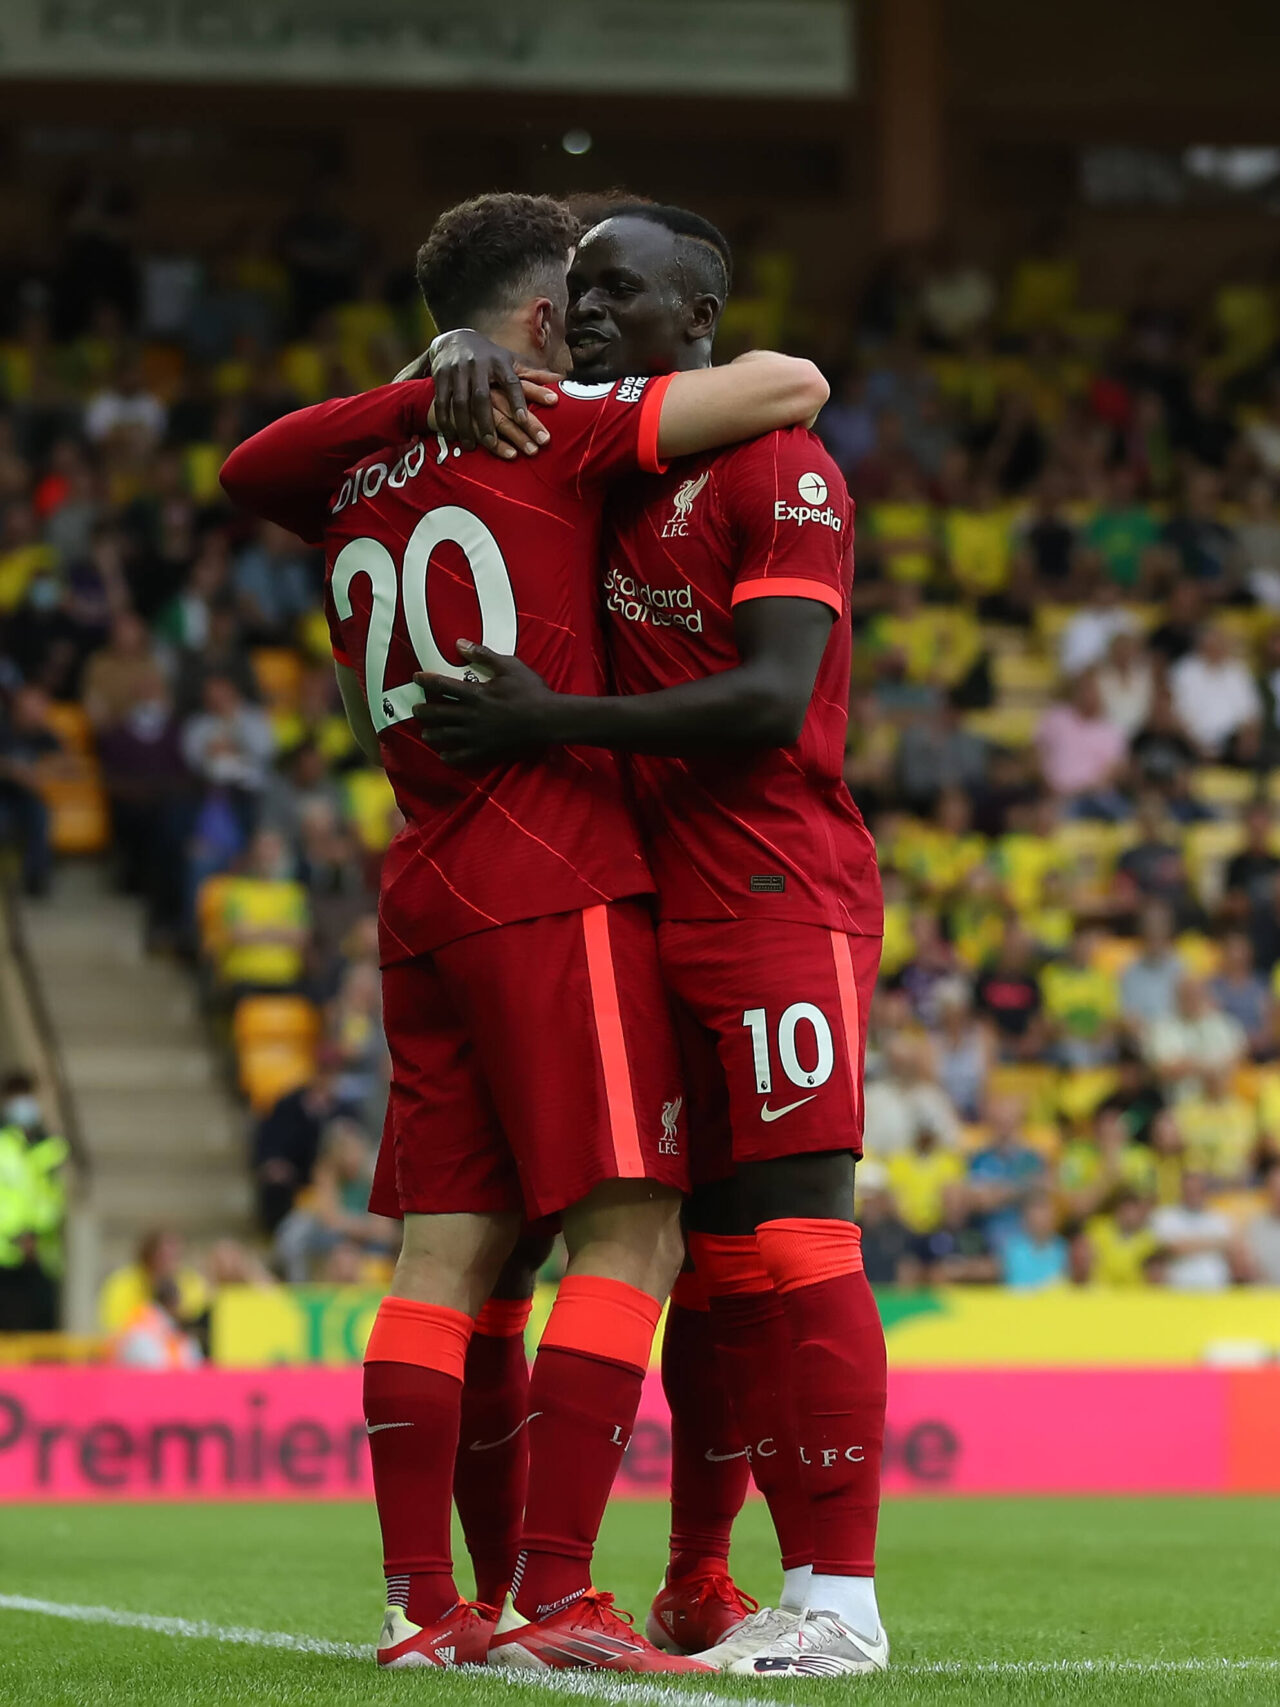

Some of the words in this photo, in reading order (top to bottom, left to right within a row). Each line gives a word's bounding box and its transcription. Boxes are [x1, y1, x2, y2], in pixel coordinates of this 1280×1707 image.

[331, 441, 425, 514] DIOGO
[774, 500, 842, 532] Expedia
[331, 505, 519, 734] 20
[604, 568, 693, 609] stadard
[742, 1002, 835, 1095] 10
